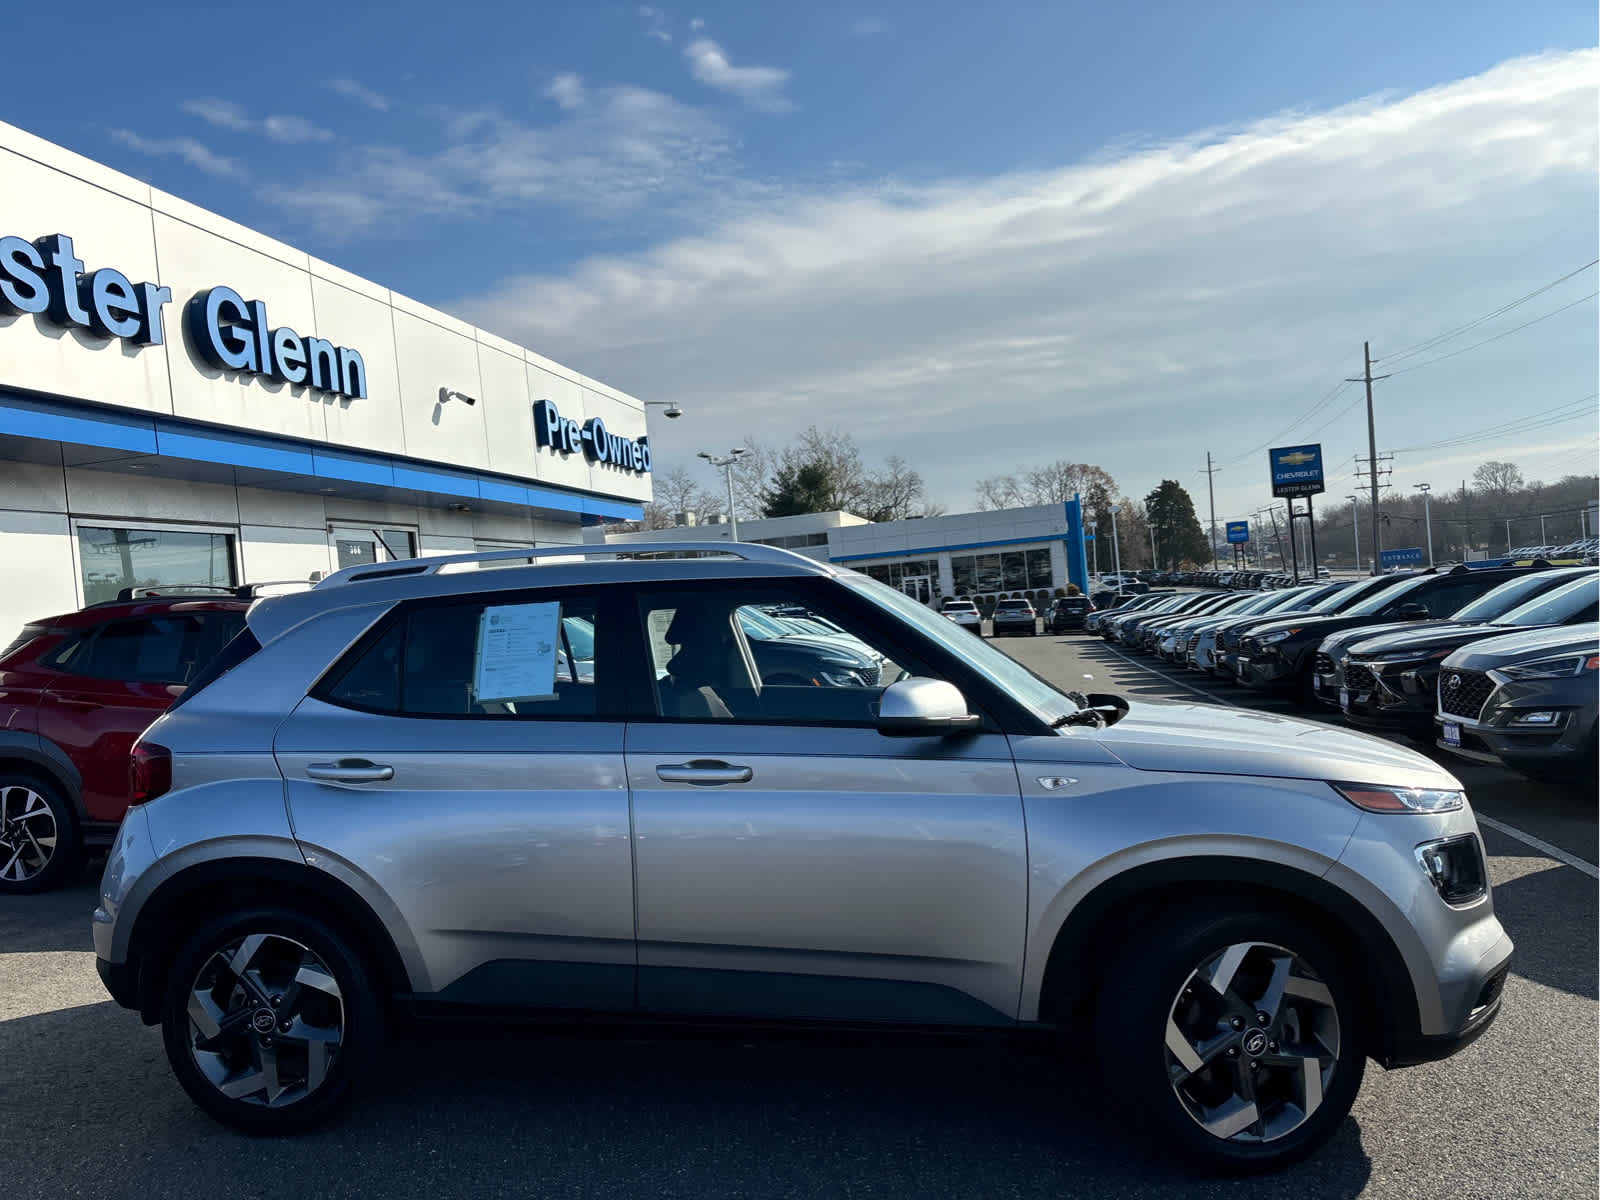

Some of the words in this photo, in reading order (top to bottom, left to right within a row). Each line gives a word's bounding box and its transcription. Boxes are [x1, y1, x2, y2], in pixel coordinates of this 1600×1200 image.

[0, 233, 172, 346] ster
[188, 285, 368, 400] Glenn
[532, 399, 652, 473] Pre-Owned
[1276, 470, 1320, 480] CHEVROLET
[1383, 552, 1421, 561] ENTRANCE
